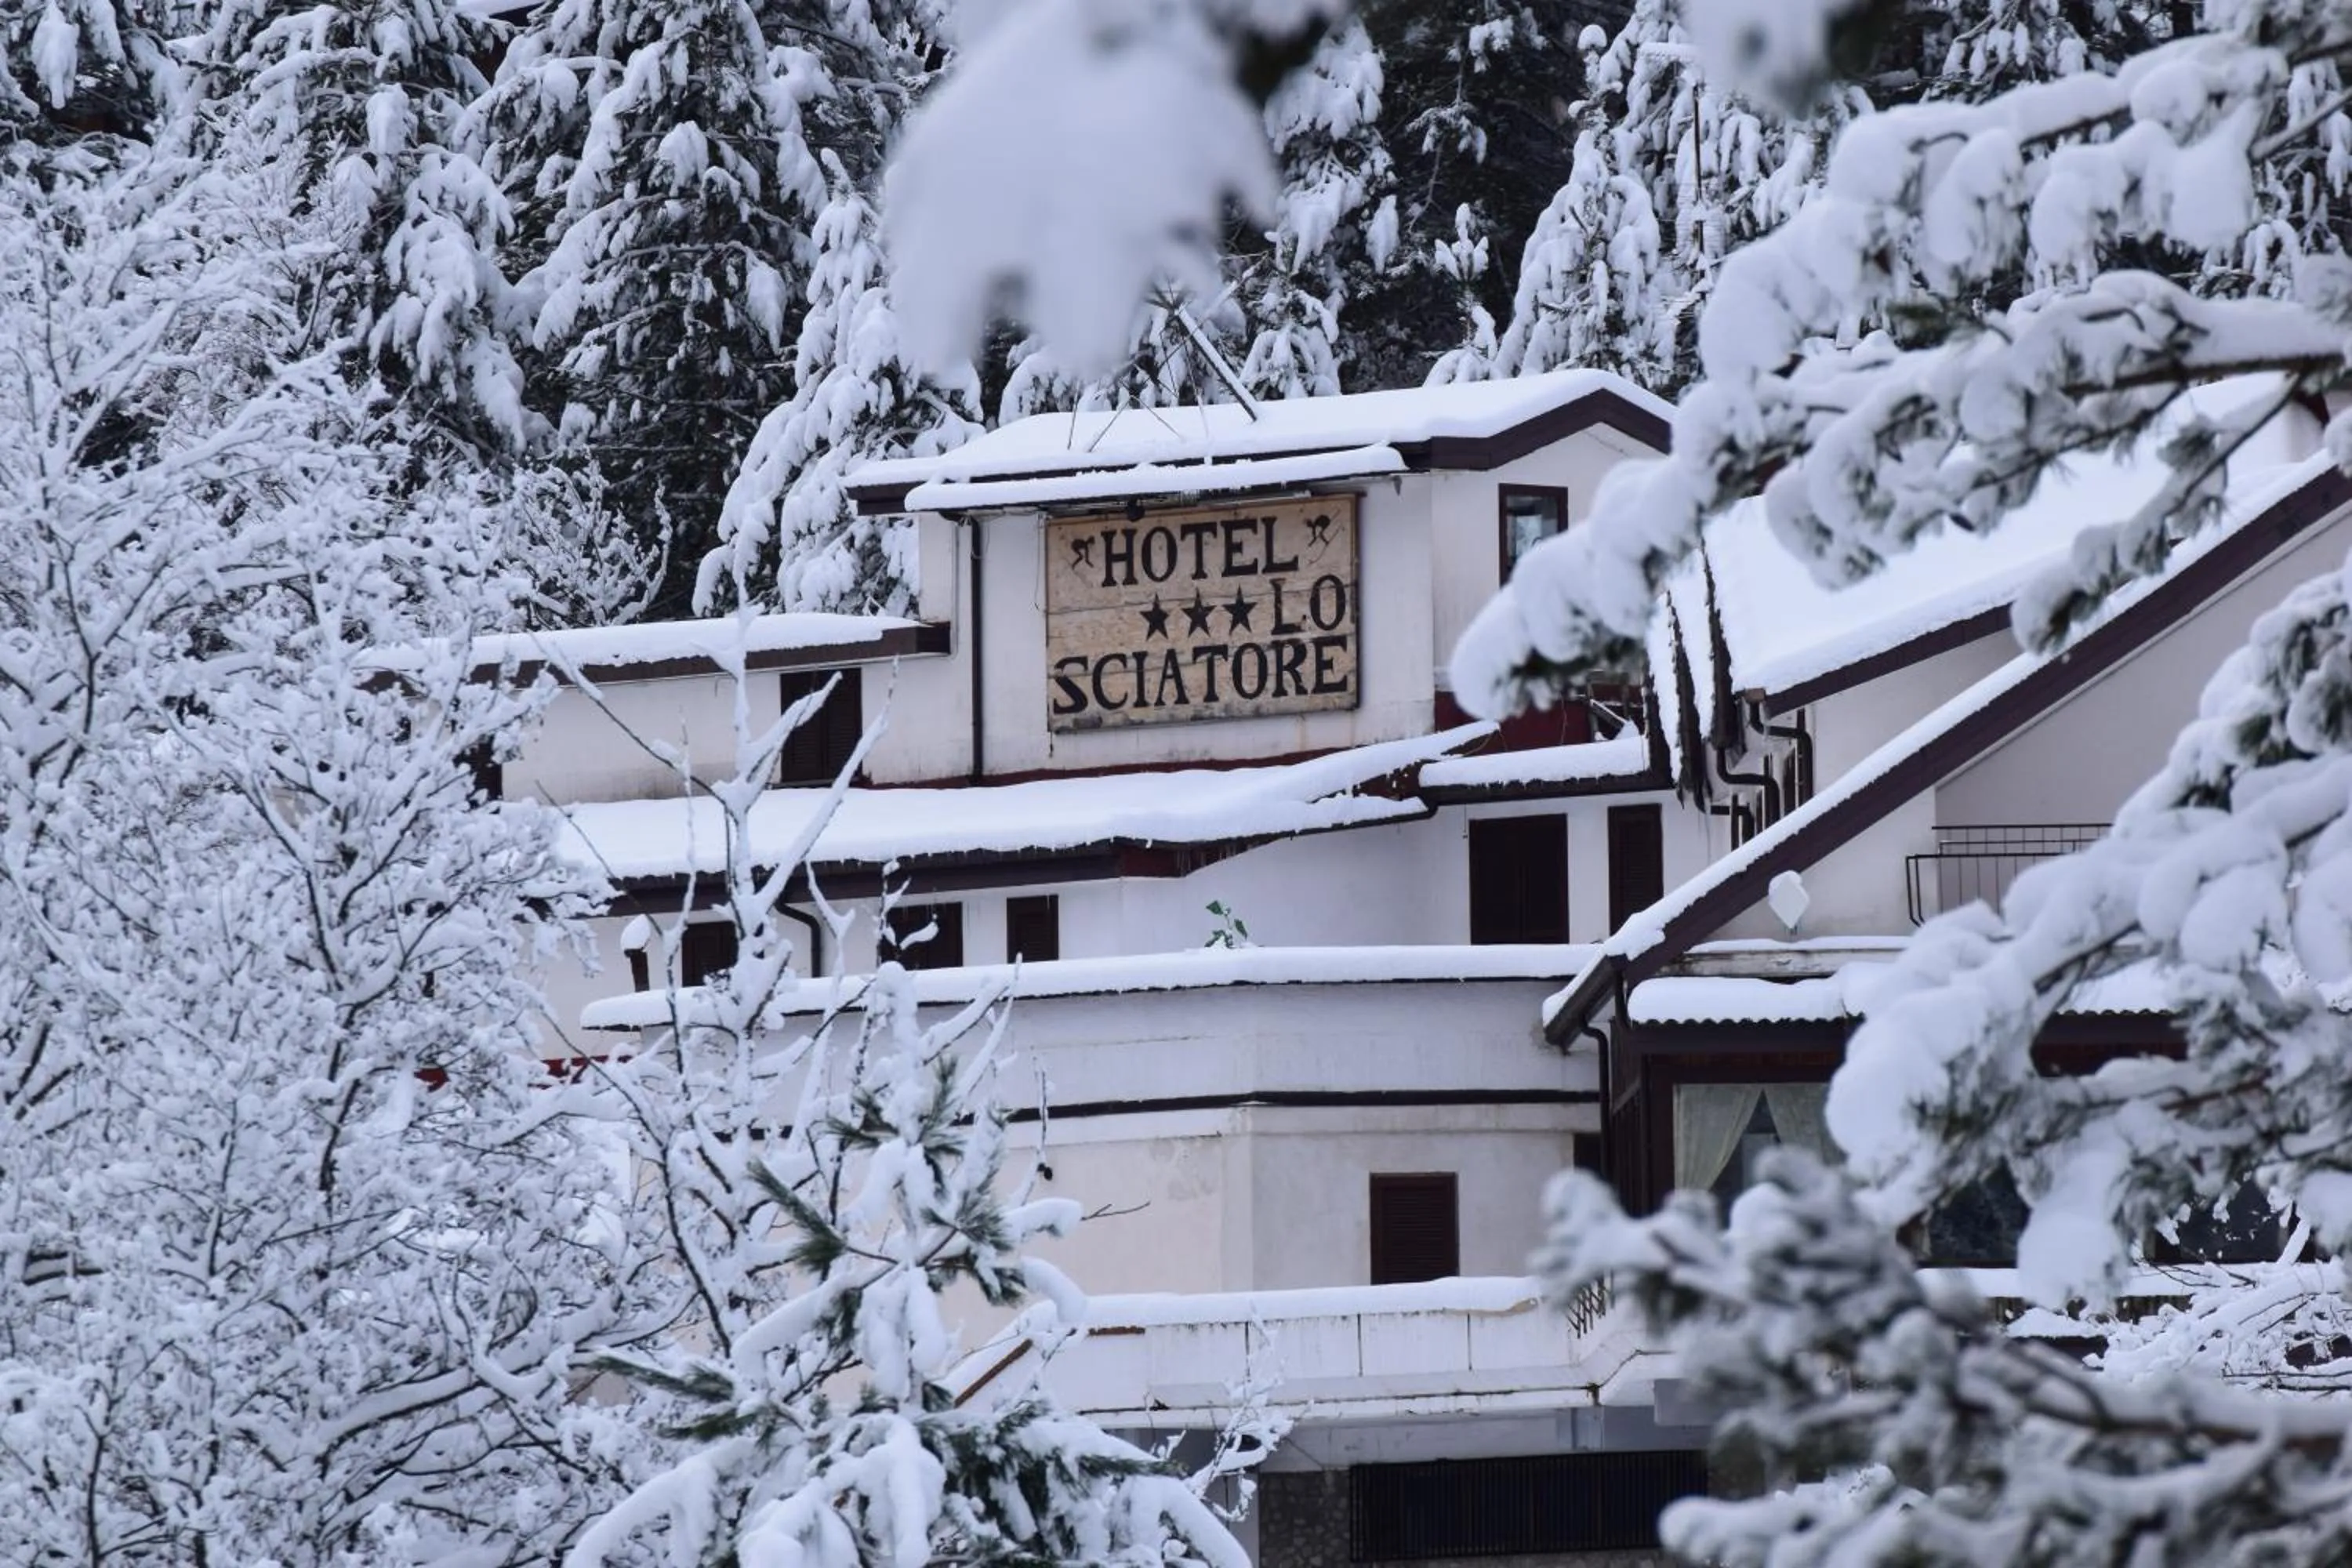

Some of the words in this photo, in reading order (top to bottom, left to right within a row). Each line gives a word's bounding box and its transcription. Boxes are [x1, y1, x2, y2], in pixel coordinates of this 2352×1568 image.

[1102, 517, 1299, 587] HOTEL
[1270, 575, 1346, 635] LO
[1053, 636, 1348, 715] SCIATORE
